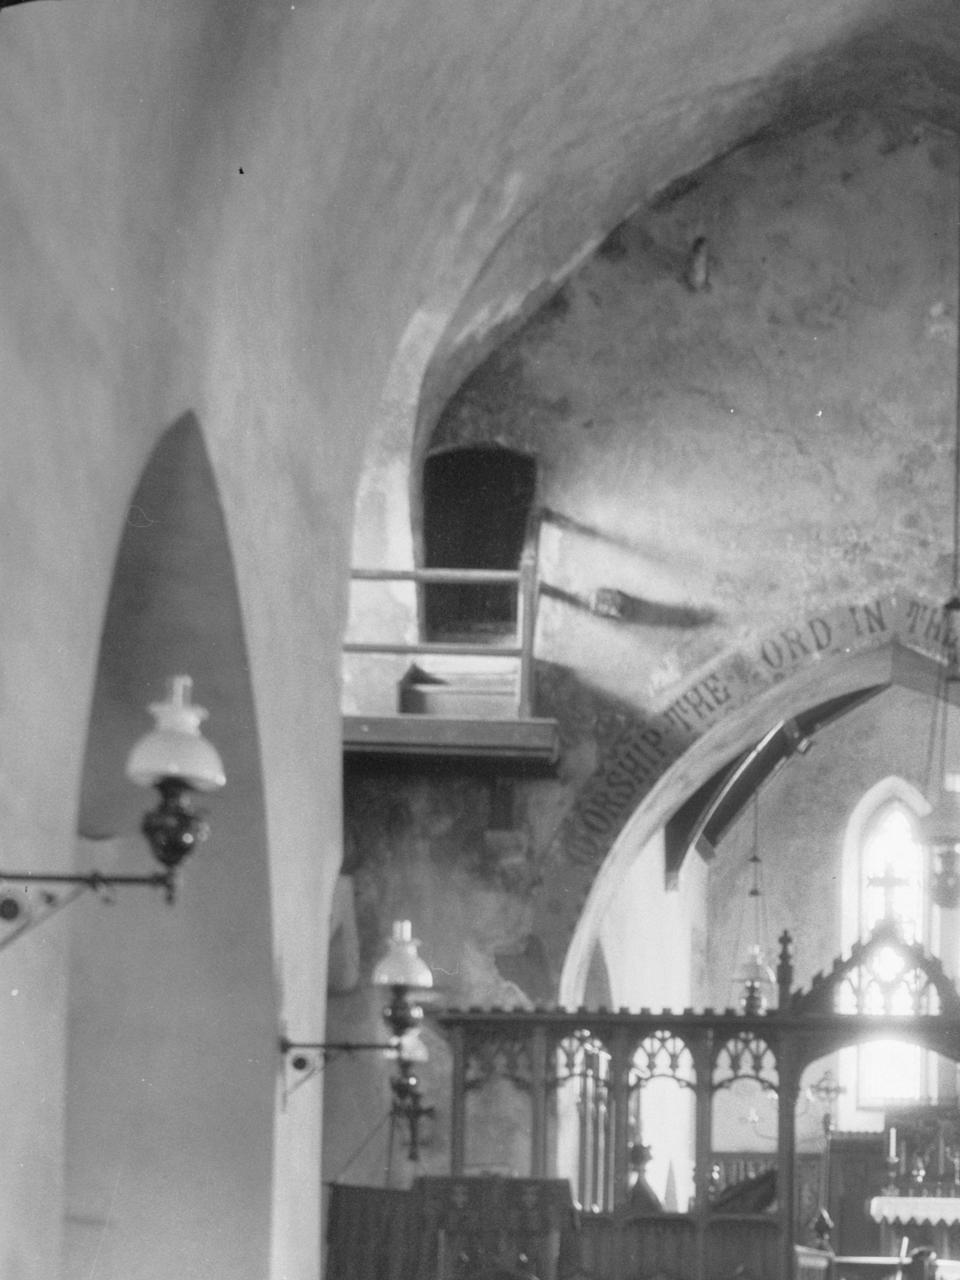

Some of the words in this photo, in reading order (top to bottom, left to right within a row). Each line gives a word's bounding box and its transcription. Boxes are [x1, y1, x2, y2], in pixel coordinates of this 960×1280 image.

[663, 673, 732, 732] THE
[740, 617, 832, 677] ORD
[848, 600, 888, 637] IN
